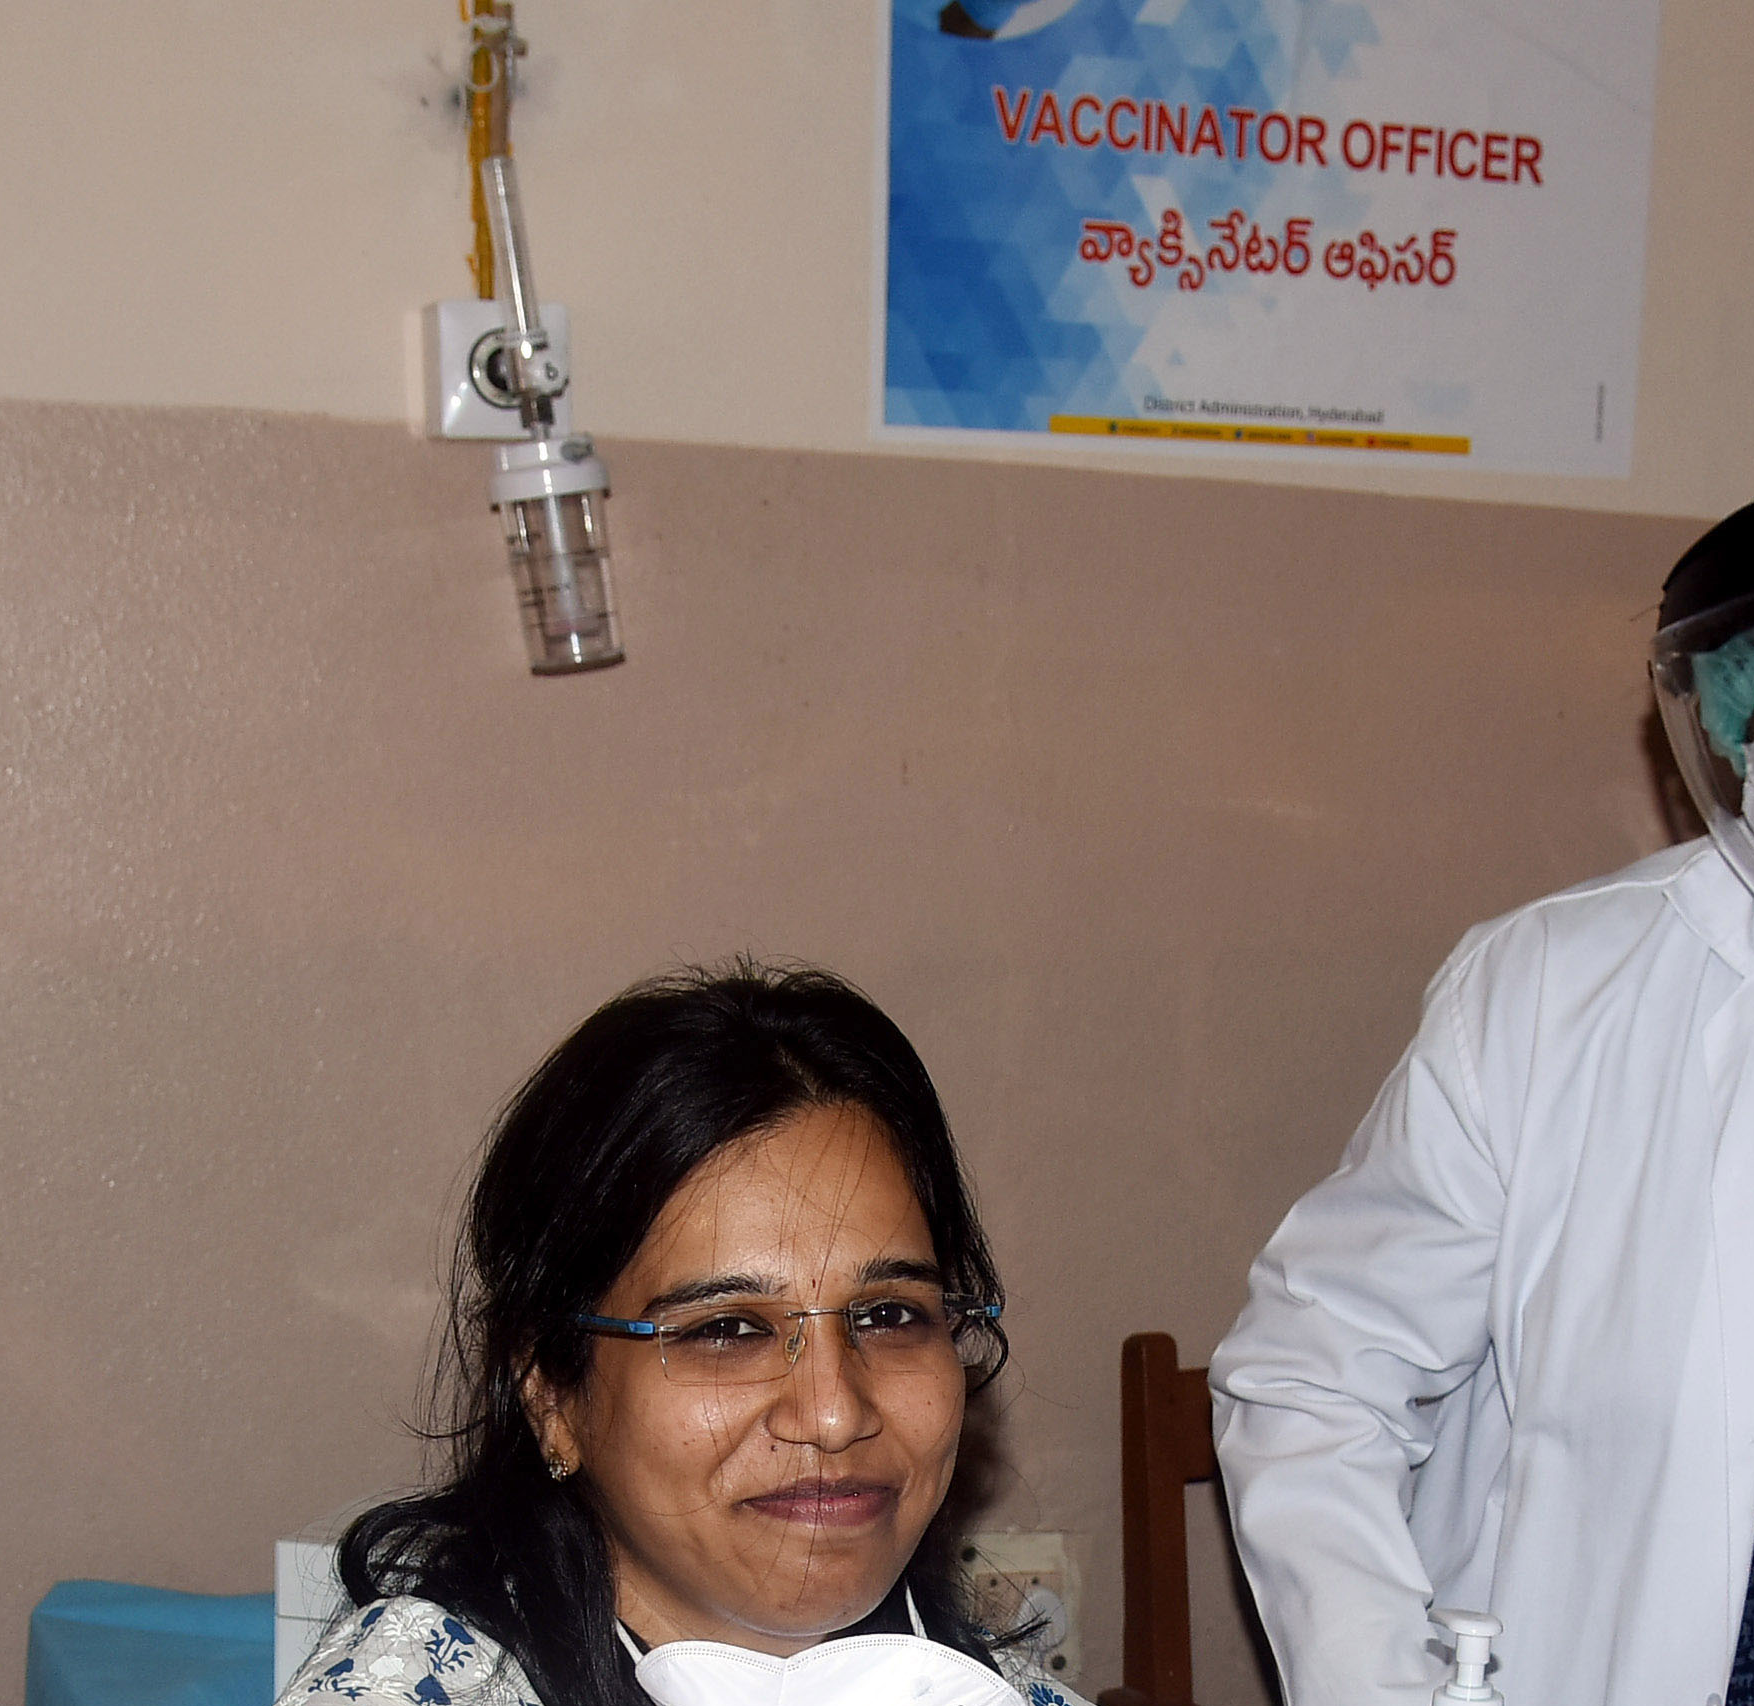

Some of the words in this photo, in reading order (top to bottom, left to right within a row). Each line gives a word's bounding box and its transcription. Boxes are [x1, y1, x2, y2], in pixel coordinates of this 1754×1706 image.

[994, 89, 1328, 168] VACCINATOR
[1341, 119, 1544, 186] OFFICER
[1143, 394, 1196, 414] District
[1308, 407, 1386, 425] Hyderabad
